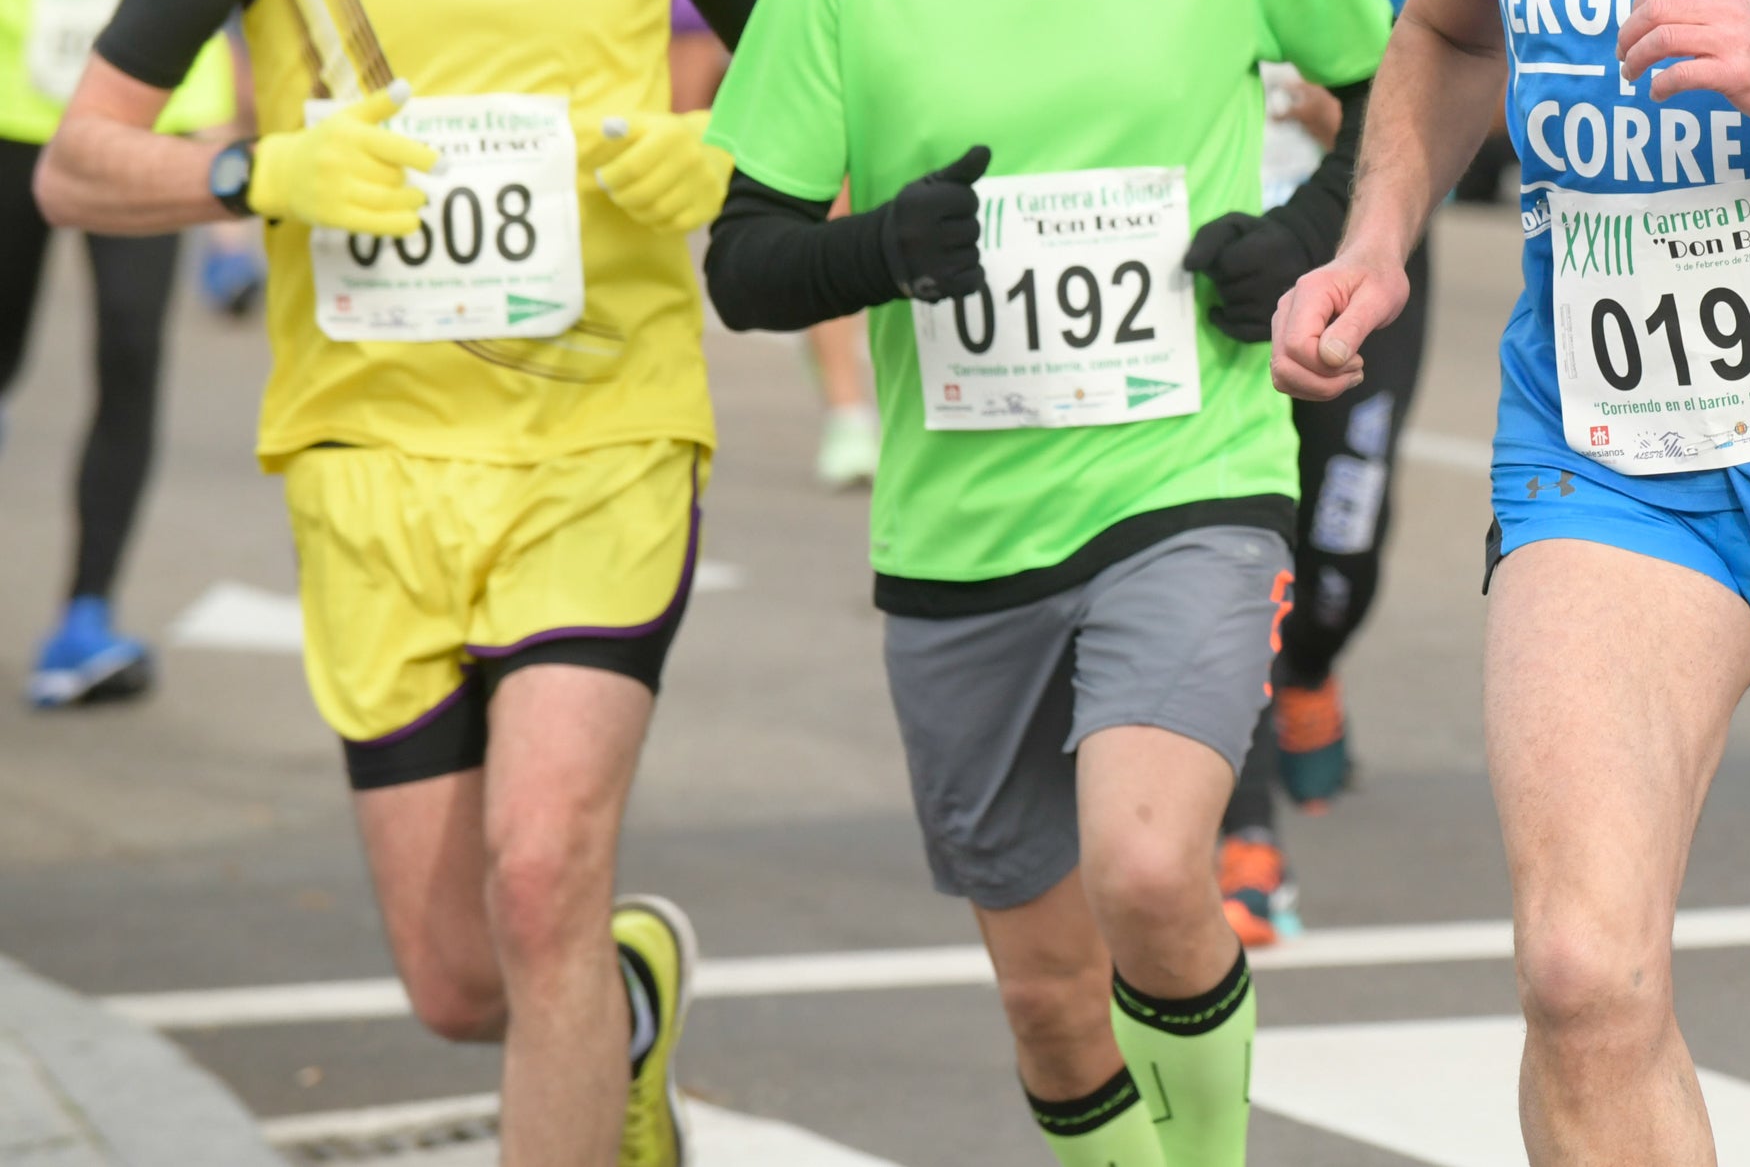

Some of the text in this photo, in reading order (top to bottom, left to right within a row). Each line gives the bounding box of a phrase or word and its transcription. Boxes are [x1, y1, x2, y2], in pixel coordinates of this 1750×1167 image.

[1526, 100, 1747, 183] CORRE
[1561, 211, 1633, 278] XXIII
[1643, 206, 1729, 236] Carrera
[1683, 260, 1694, 271] de
[1695, 257, 1730, 270] febrero
[1732, 254, 1742, 266] de
[953, 260, 1155, 355] 0192
[1666, 400, 1680, 411] en
[1684, 397, 1696, 411] el
[1700, 392, 1744, 409] barrio,
